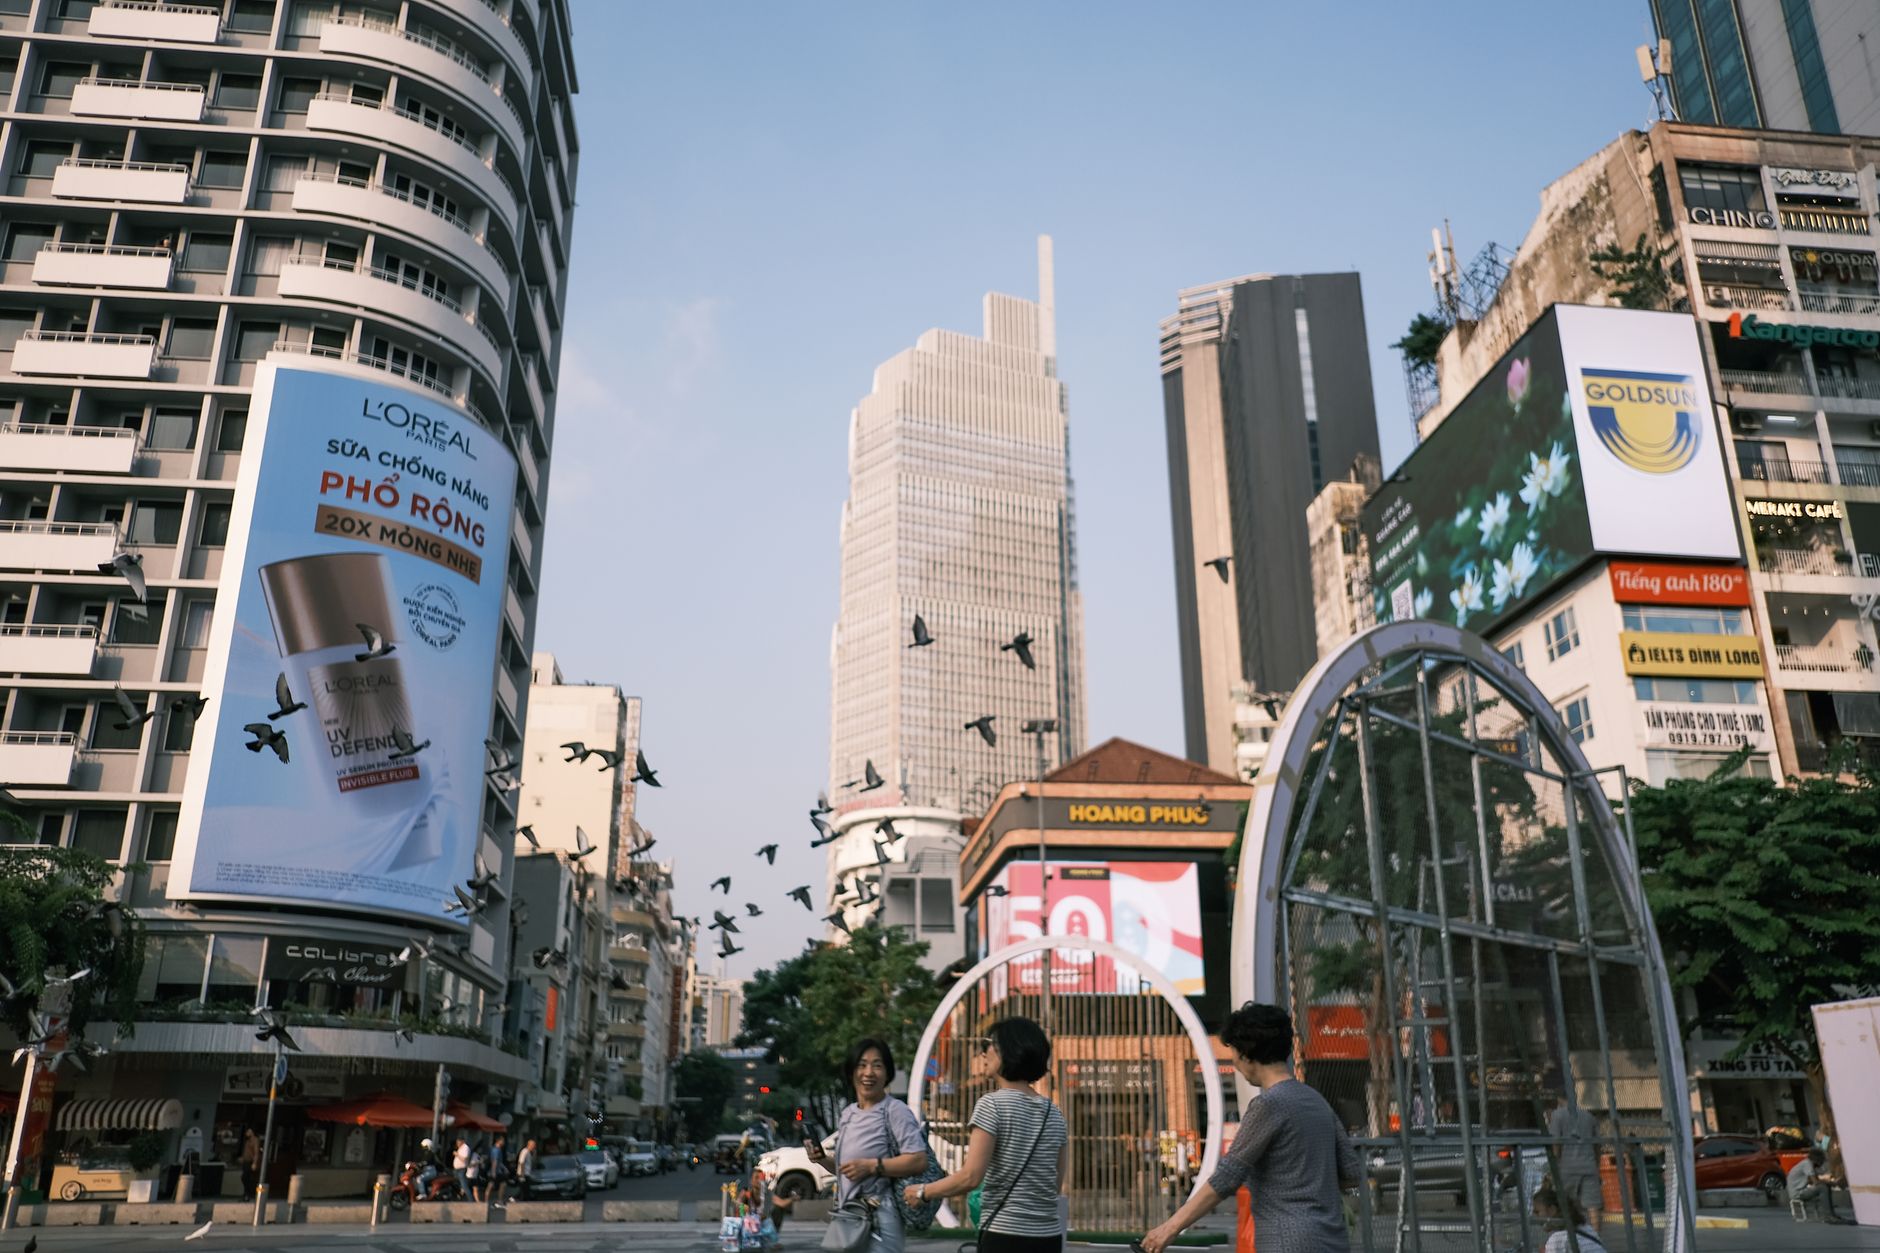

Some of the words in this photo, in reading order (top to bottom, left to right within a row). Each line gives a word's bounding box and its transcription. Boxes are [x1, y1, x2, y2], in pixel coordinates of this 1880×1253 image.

[1850, 253, 1876, 266] DAY
[1586, 383, 1697, 406] GOLDSUN
[406, 430, 446, 452] PARIS
[327, 438, 371, 462] SỮA
[378, 451, 447, 486] CHỐNG
[452, 477, 489, 511] NẮNG
[319, 470, 400, 508] PHỔ
[410, 492, 485, 548] RỘNG
[324, 513, 373, 538] 20X
[379, 523, 442, 559] MỎNG
[447, 548, 478, 580] NHẸ
[1614, 567, 1661, 596] Tiếng
[1665, 573, 1701, 592] anh
[1648, 646, 1685, 663] IELTS
[1726, 649, 1760, 665] LONG
[1697, 712, 1716, 731] CHO
[326, 728, 350, 743] UV
[341, 773, 388, 790] INVISIBLE
[389, 769, 413, 781] FLUID
[1069, 804, 1146, 823] HOANG
[1150, 805, 1209, 825] PHUC
[1708, 1061, 1747, 1072] XING
[1750, 1060, 1771, 1072] FU
